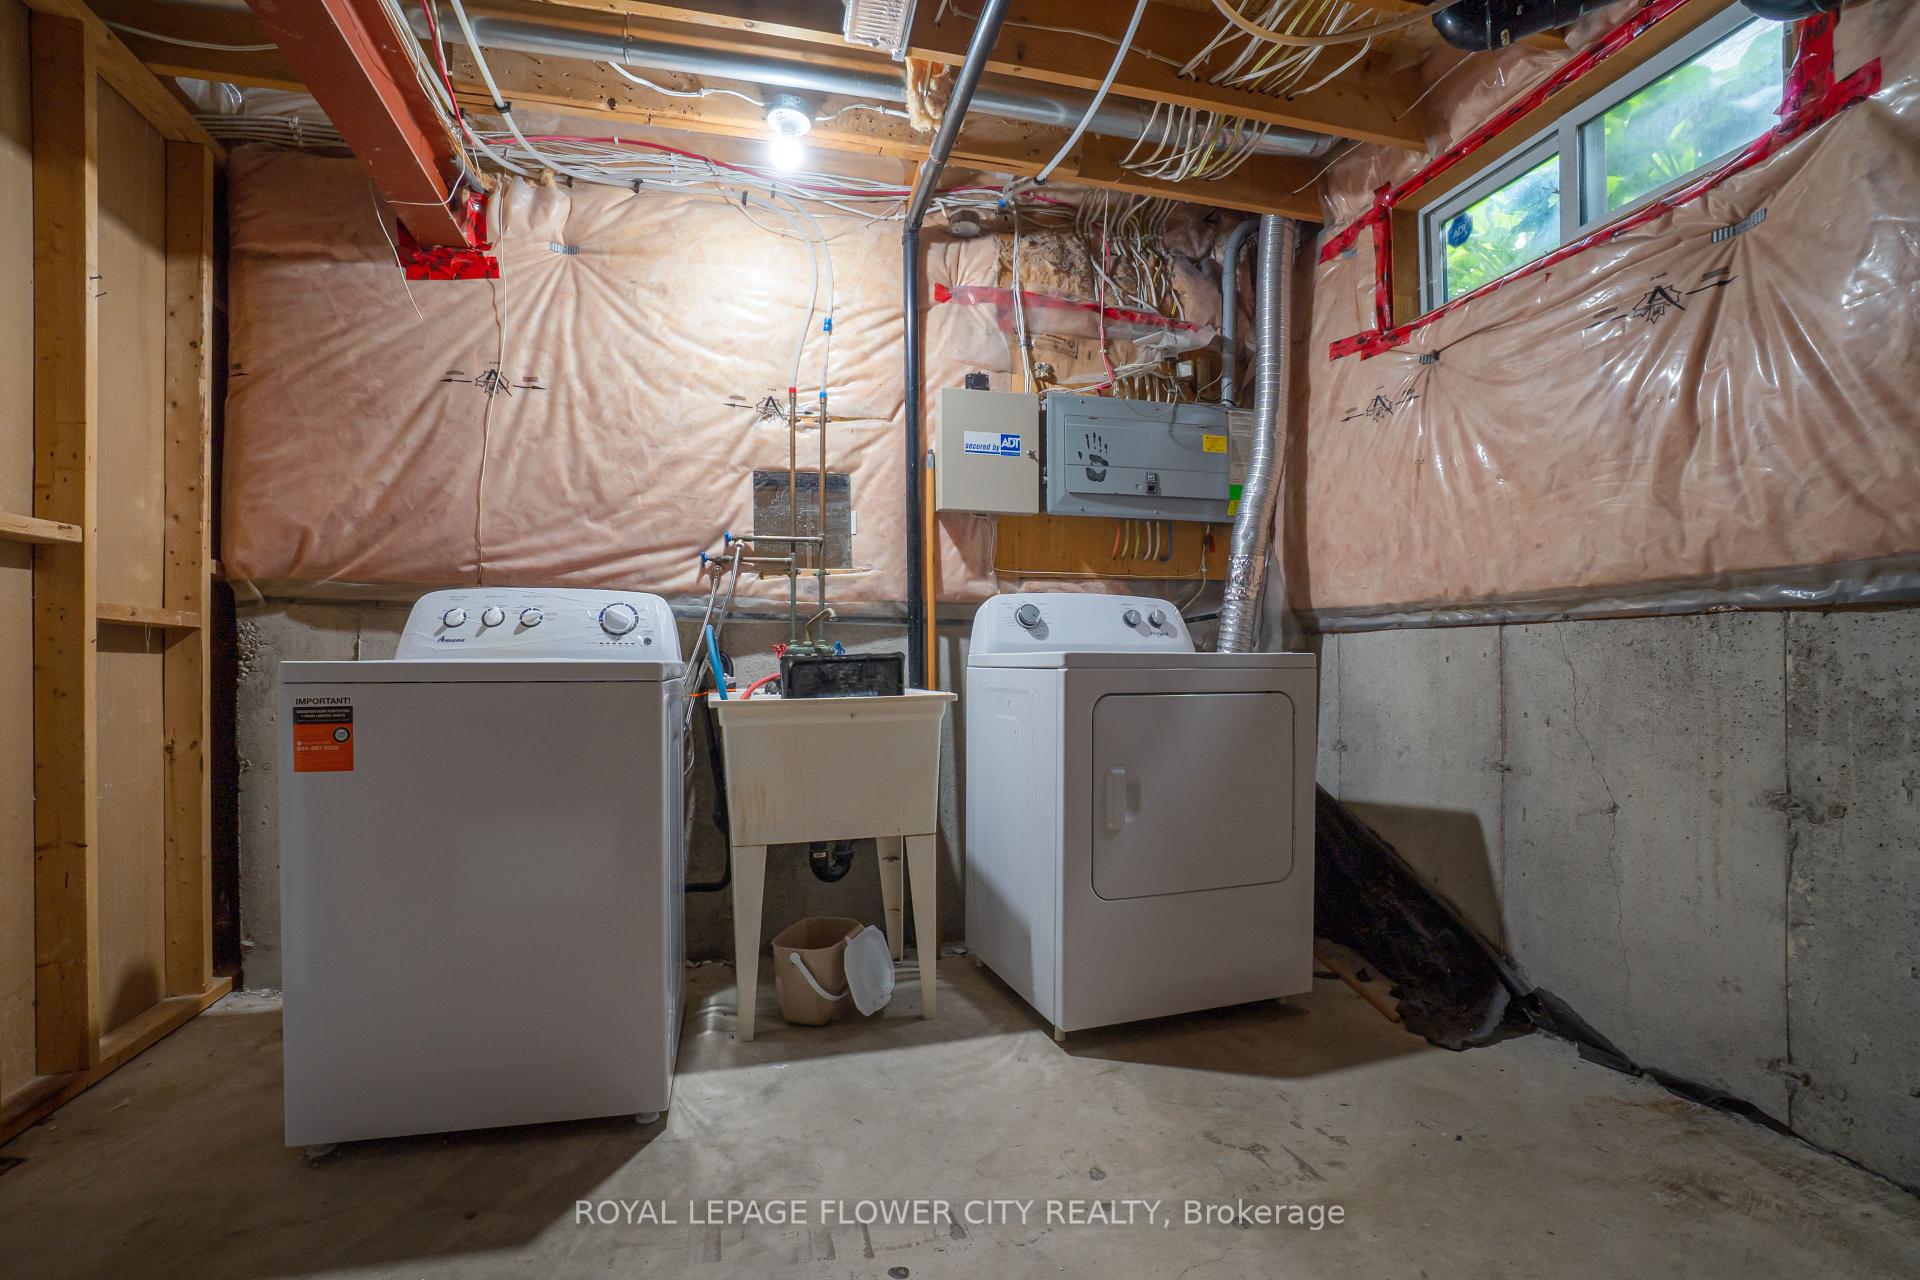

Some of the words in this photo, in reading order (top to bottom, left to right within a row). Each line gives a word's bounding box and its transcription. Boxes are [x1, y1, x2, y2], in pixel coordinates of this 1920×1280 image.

[965, 442, 991, 450] secured
[992, 443, 1000, 452] by
[1001, 437, 1020, 449] ADT
[295, 697, 351, 705] IMPORTANT!
